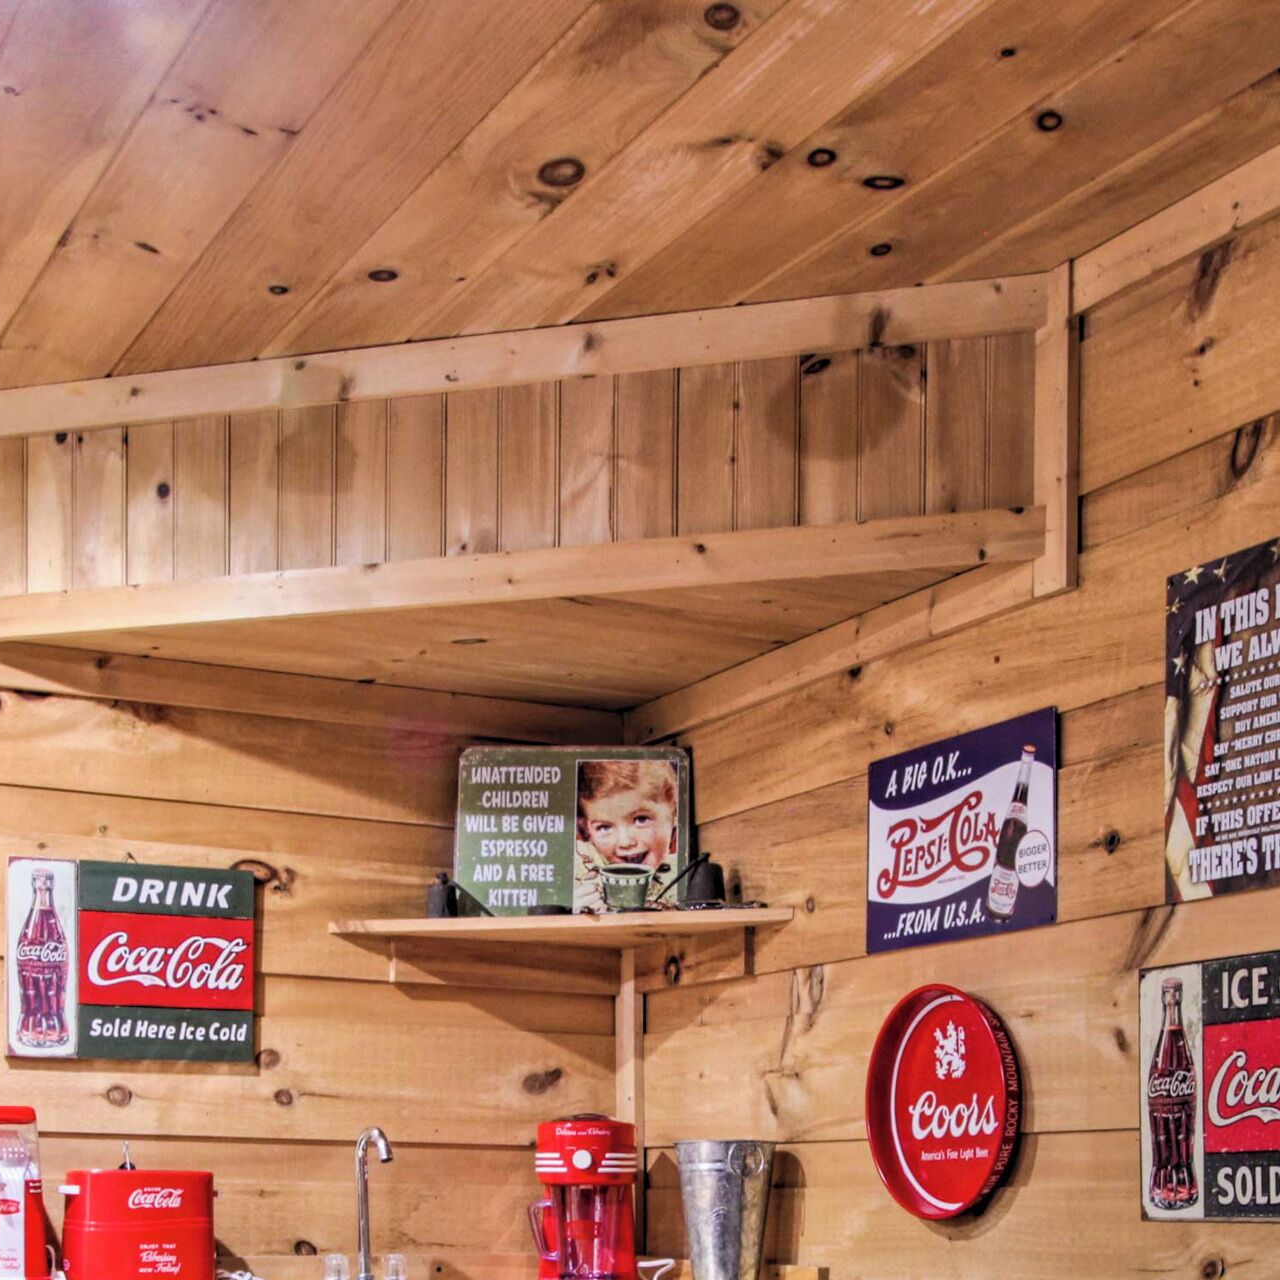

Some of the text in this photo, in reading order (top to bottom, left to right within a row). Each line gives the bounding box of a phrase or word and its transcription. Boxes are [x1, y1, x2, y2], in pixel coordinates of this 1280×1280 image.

[1195, 605, 1217, 645] IN
[1221, 588, 1269, 636] THIS
[1215, 640, 1243, 671] WE
[1230, 679, 1262, 699] SALUTE
[1263, 674, 1280, 689] OUR
[1220, 699, 1259, 720] SUPPORT
[1260, 693, 1277, 709] OUR
[1235, 718, 1252, 733] BUY
[1204, 762, 1220, 777] SAY
[1244, 749, 1276, 768] NATION
[1213, 742, 1229, 757] SAY
[471, 765, 561, 784] UNATTENDED
[885, 770, 897, 798] A
[902, 757, 927, 795] BIG
[1196, 778, 1234, 798] RESPECT
[1235, 775, 1252, 789] OUR
[1254, 770, 1273, 785] LAW
[482, 791, 549, 808] CHILDREN
[465, 815, 564, 833] WILL BE GIVEN
[1195, 815, 1209, 837] IF
[1211, 808, 1243, 833] THIS
[481, 839, 548, 857] ESPRESSO
[1018, 842, 1047, 858] BIGGER
[1189, 837, 1258, 883] THERE'S
[473, 864, 554, 882] AND A FREE
[1018, 859, 1047, 874] BETTER
[112, 876, 233, 909] DRINK
[488, 888, 537, 907] KITTEN
[943, 898, 986, 928] U.S.A.
[1221, 966, 1268, 1009] ICE
[89, 1018, 248, 1042] Sold Here Ice Cold
[995, 1031, 1018, 1091] MOUNTAIN
[908, 1091, 999, 1140] Coors
[1005, 1099, 1019, 1137] ROCKY
[994, 1143, 1013, 1170] PURE
